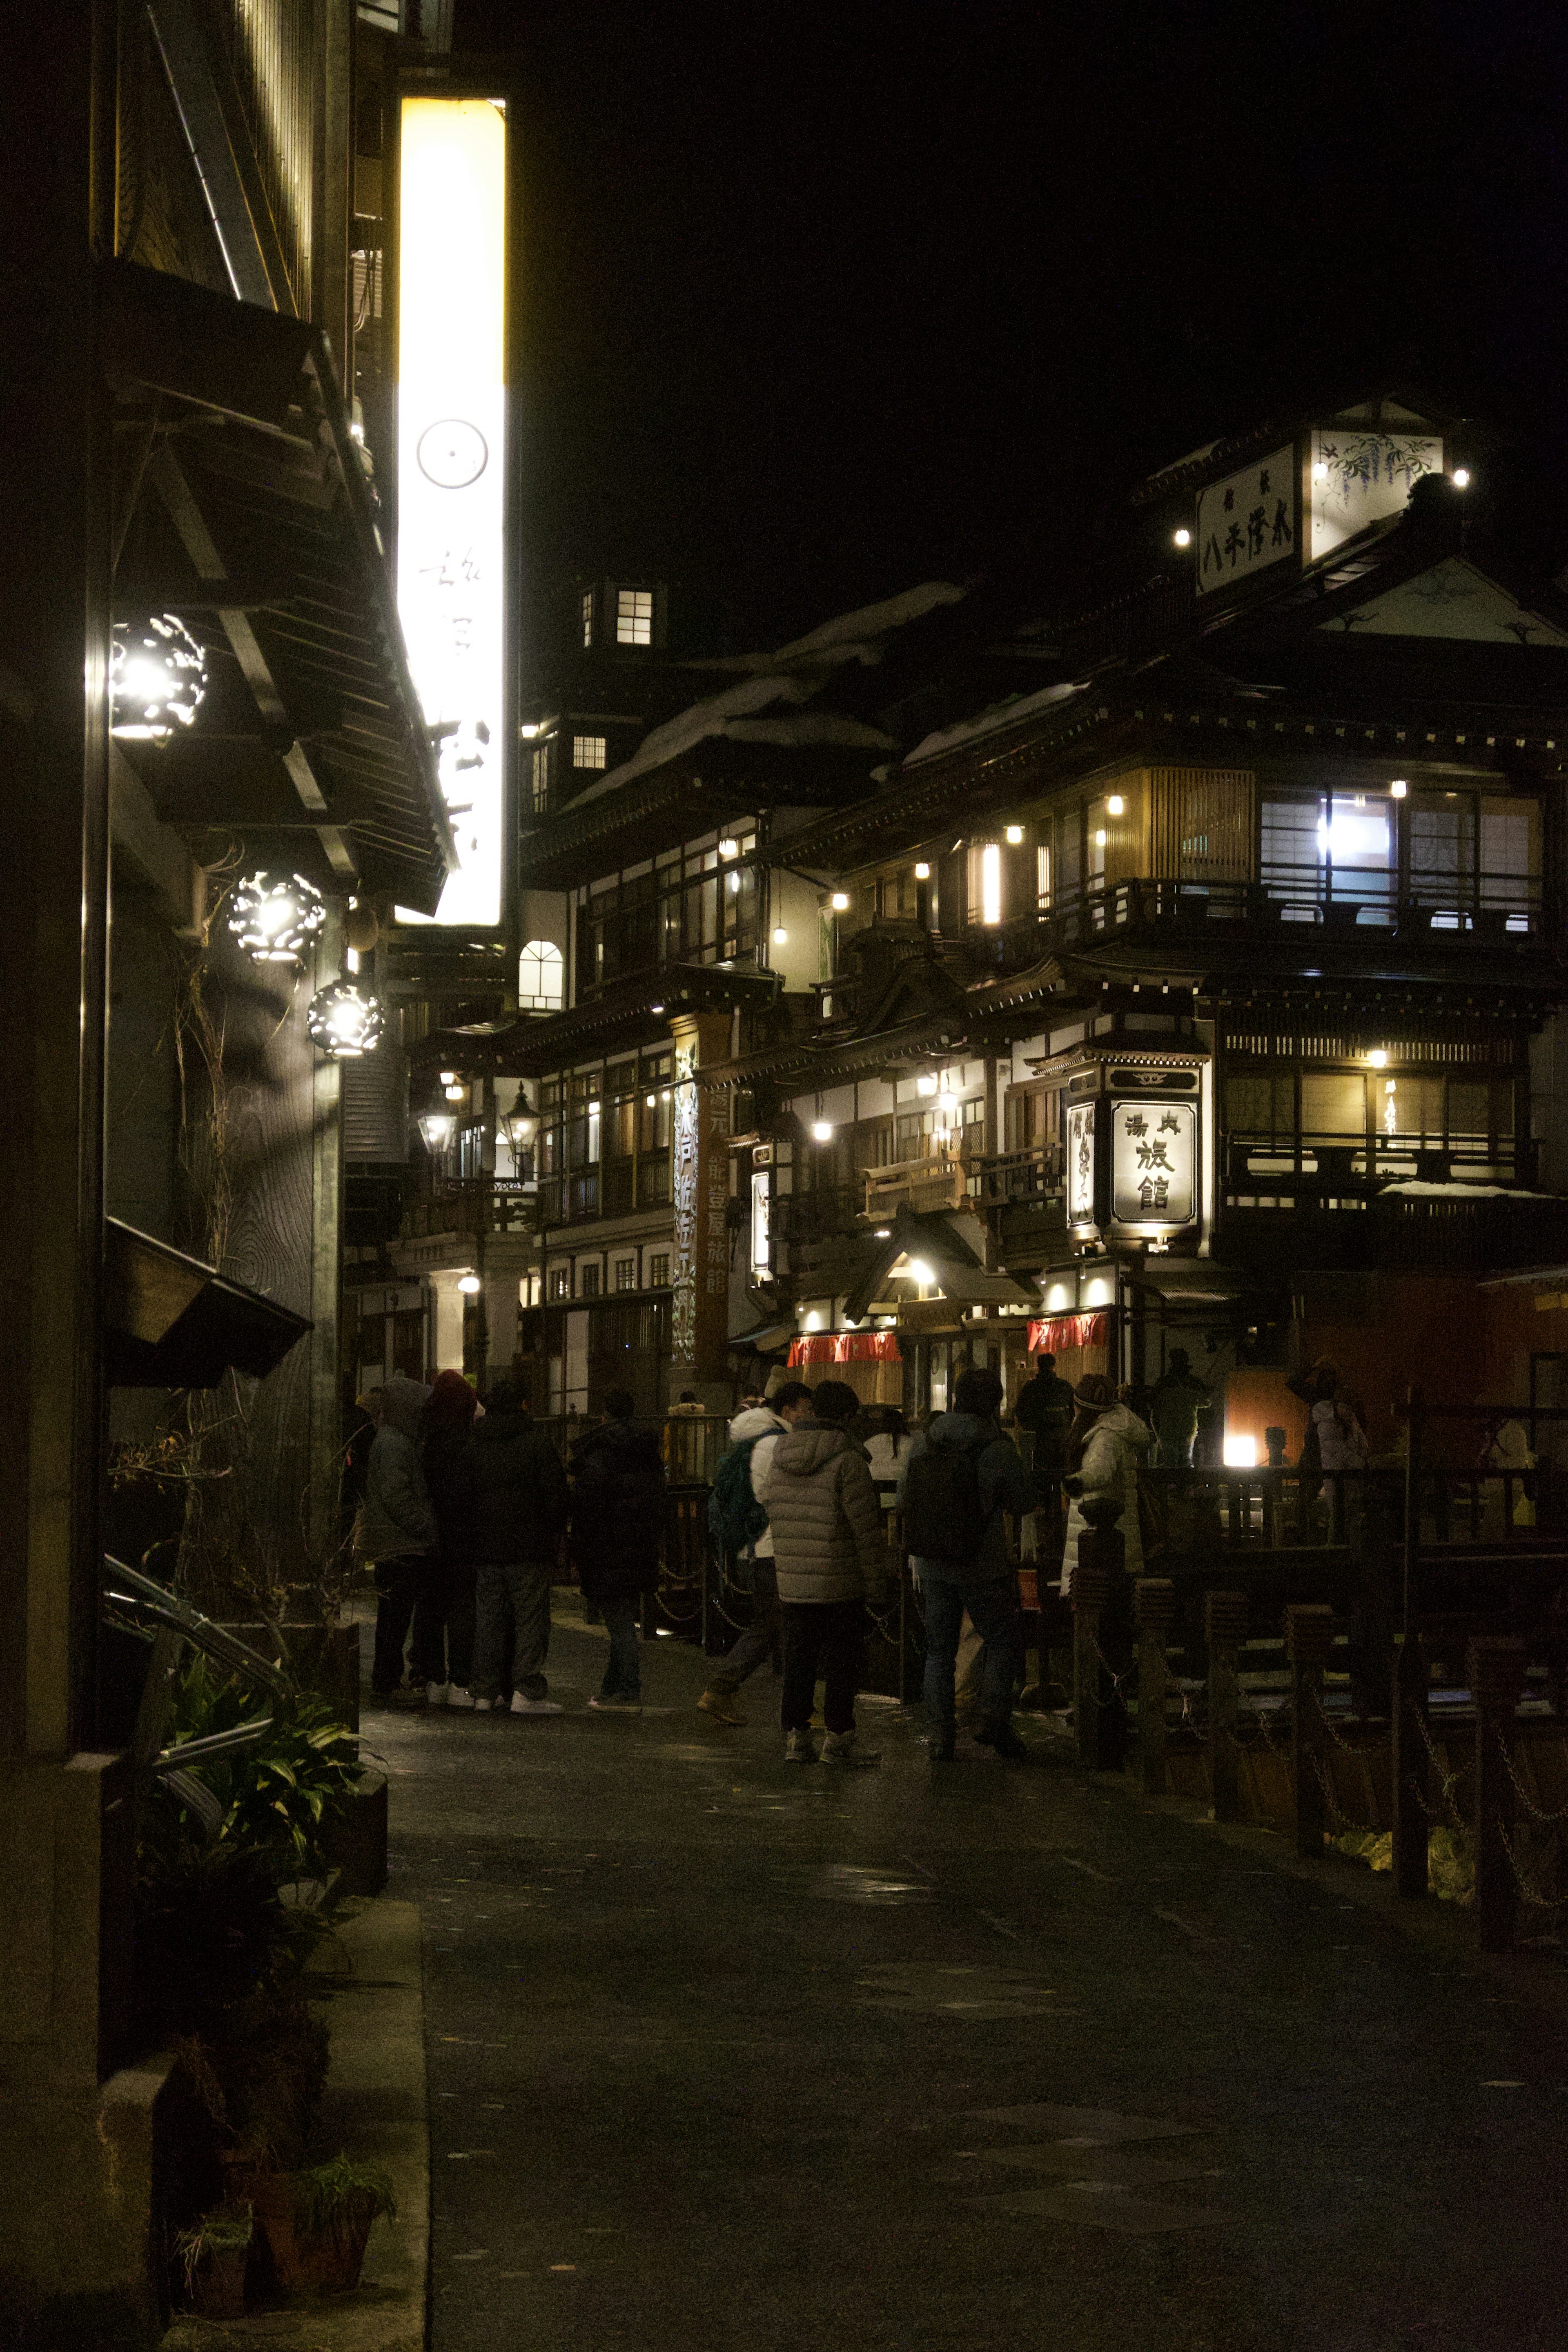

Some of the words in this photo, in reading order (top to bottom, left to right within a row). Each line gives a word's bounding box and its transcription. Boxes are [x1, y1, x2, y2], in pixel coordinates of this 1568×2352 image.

[1125, 1110, 1182, 1138] 内湯
[706, 1155, 728, 1295] 能登屋旅館
